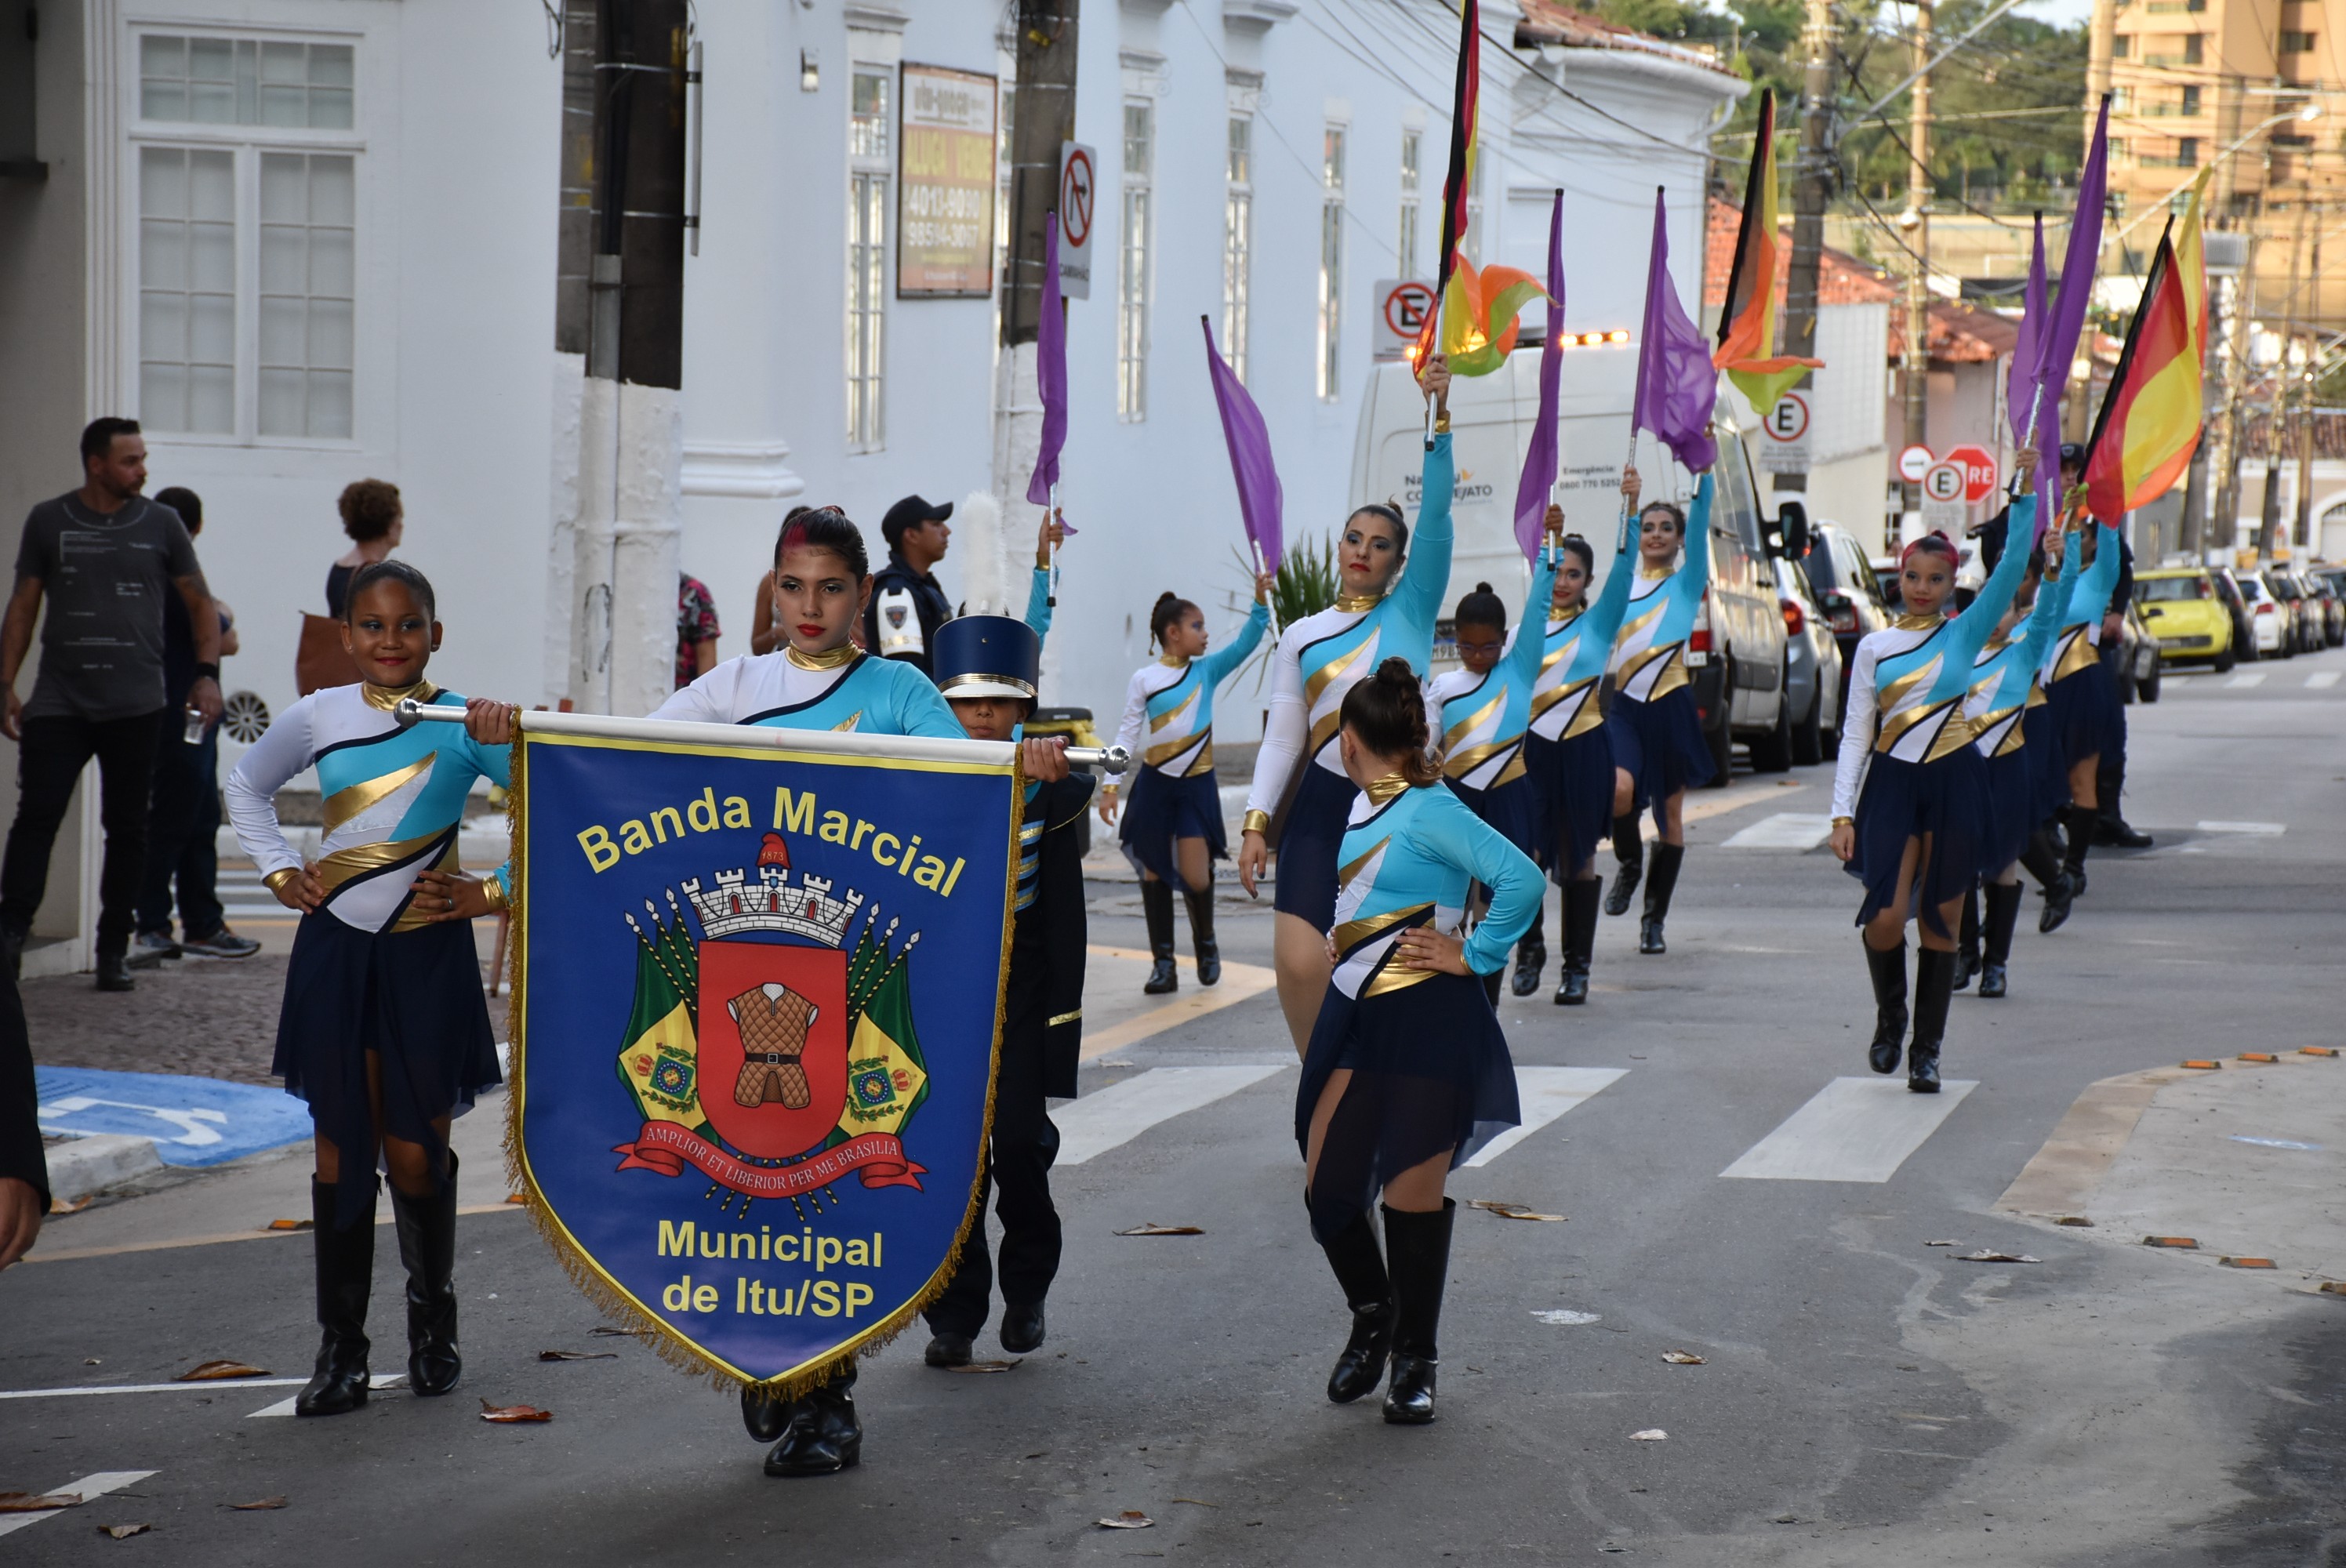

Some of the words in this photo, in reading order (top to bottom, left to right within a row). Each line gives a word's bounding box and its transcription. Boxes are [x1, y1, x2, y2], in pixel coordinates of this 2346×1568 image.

[1401, 293, 1425, 326] E
[1778, 404, 1794, 431] E
[1937, 471, 1951, 493] E
[1970, 466, 1992, 484] RE
[576, 786, 751, 874] Banda
[772, 786, 966, 898] Marcial
[762, 851, 784, 861] 1873
[646, 1127, 707, 1160] AMPLIOR
[706, 1154, 726, 1173] ET
[724, 1165, 786, 1190] LIBERIOR
[789, 1168, 815, 1187] PER
[815, 1158, 837, 1178] ME
[836, 1141, 898, 1167] BRASILIA
[657, 1220, 882, 1272] Municipal
[663, 1275, 718, 1312] de
[736, 1277, 874, 1318] Itu/SP
